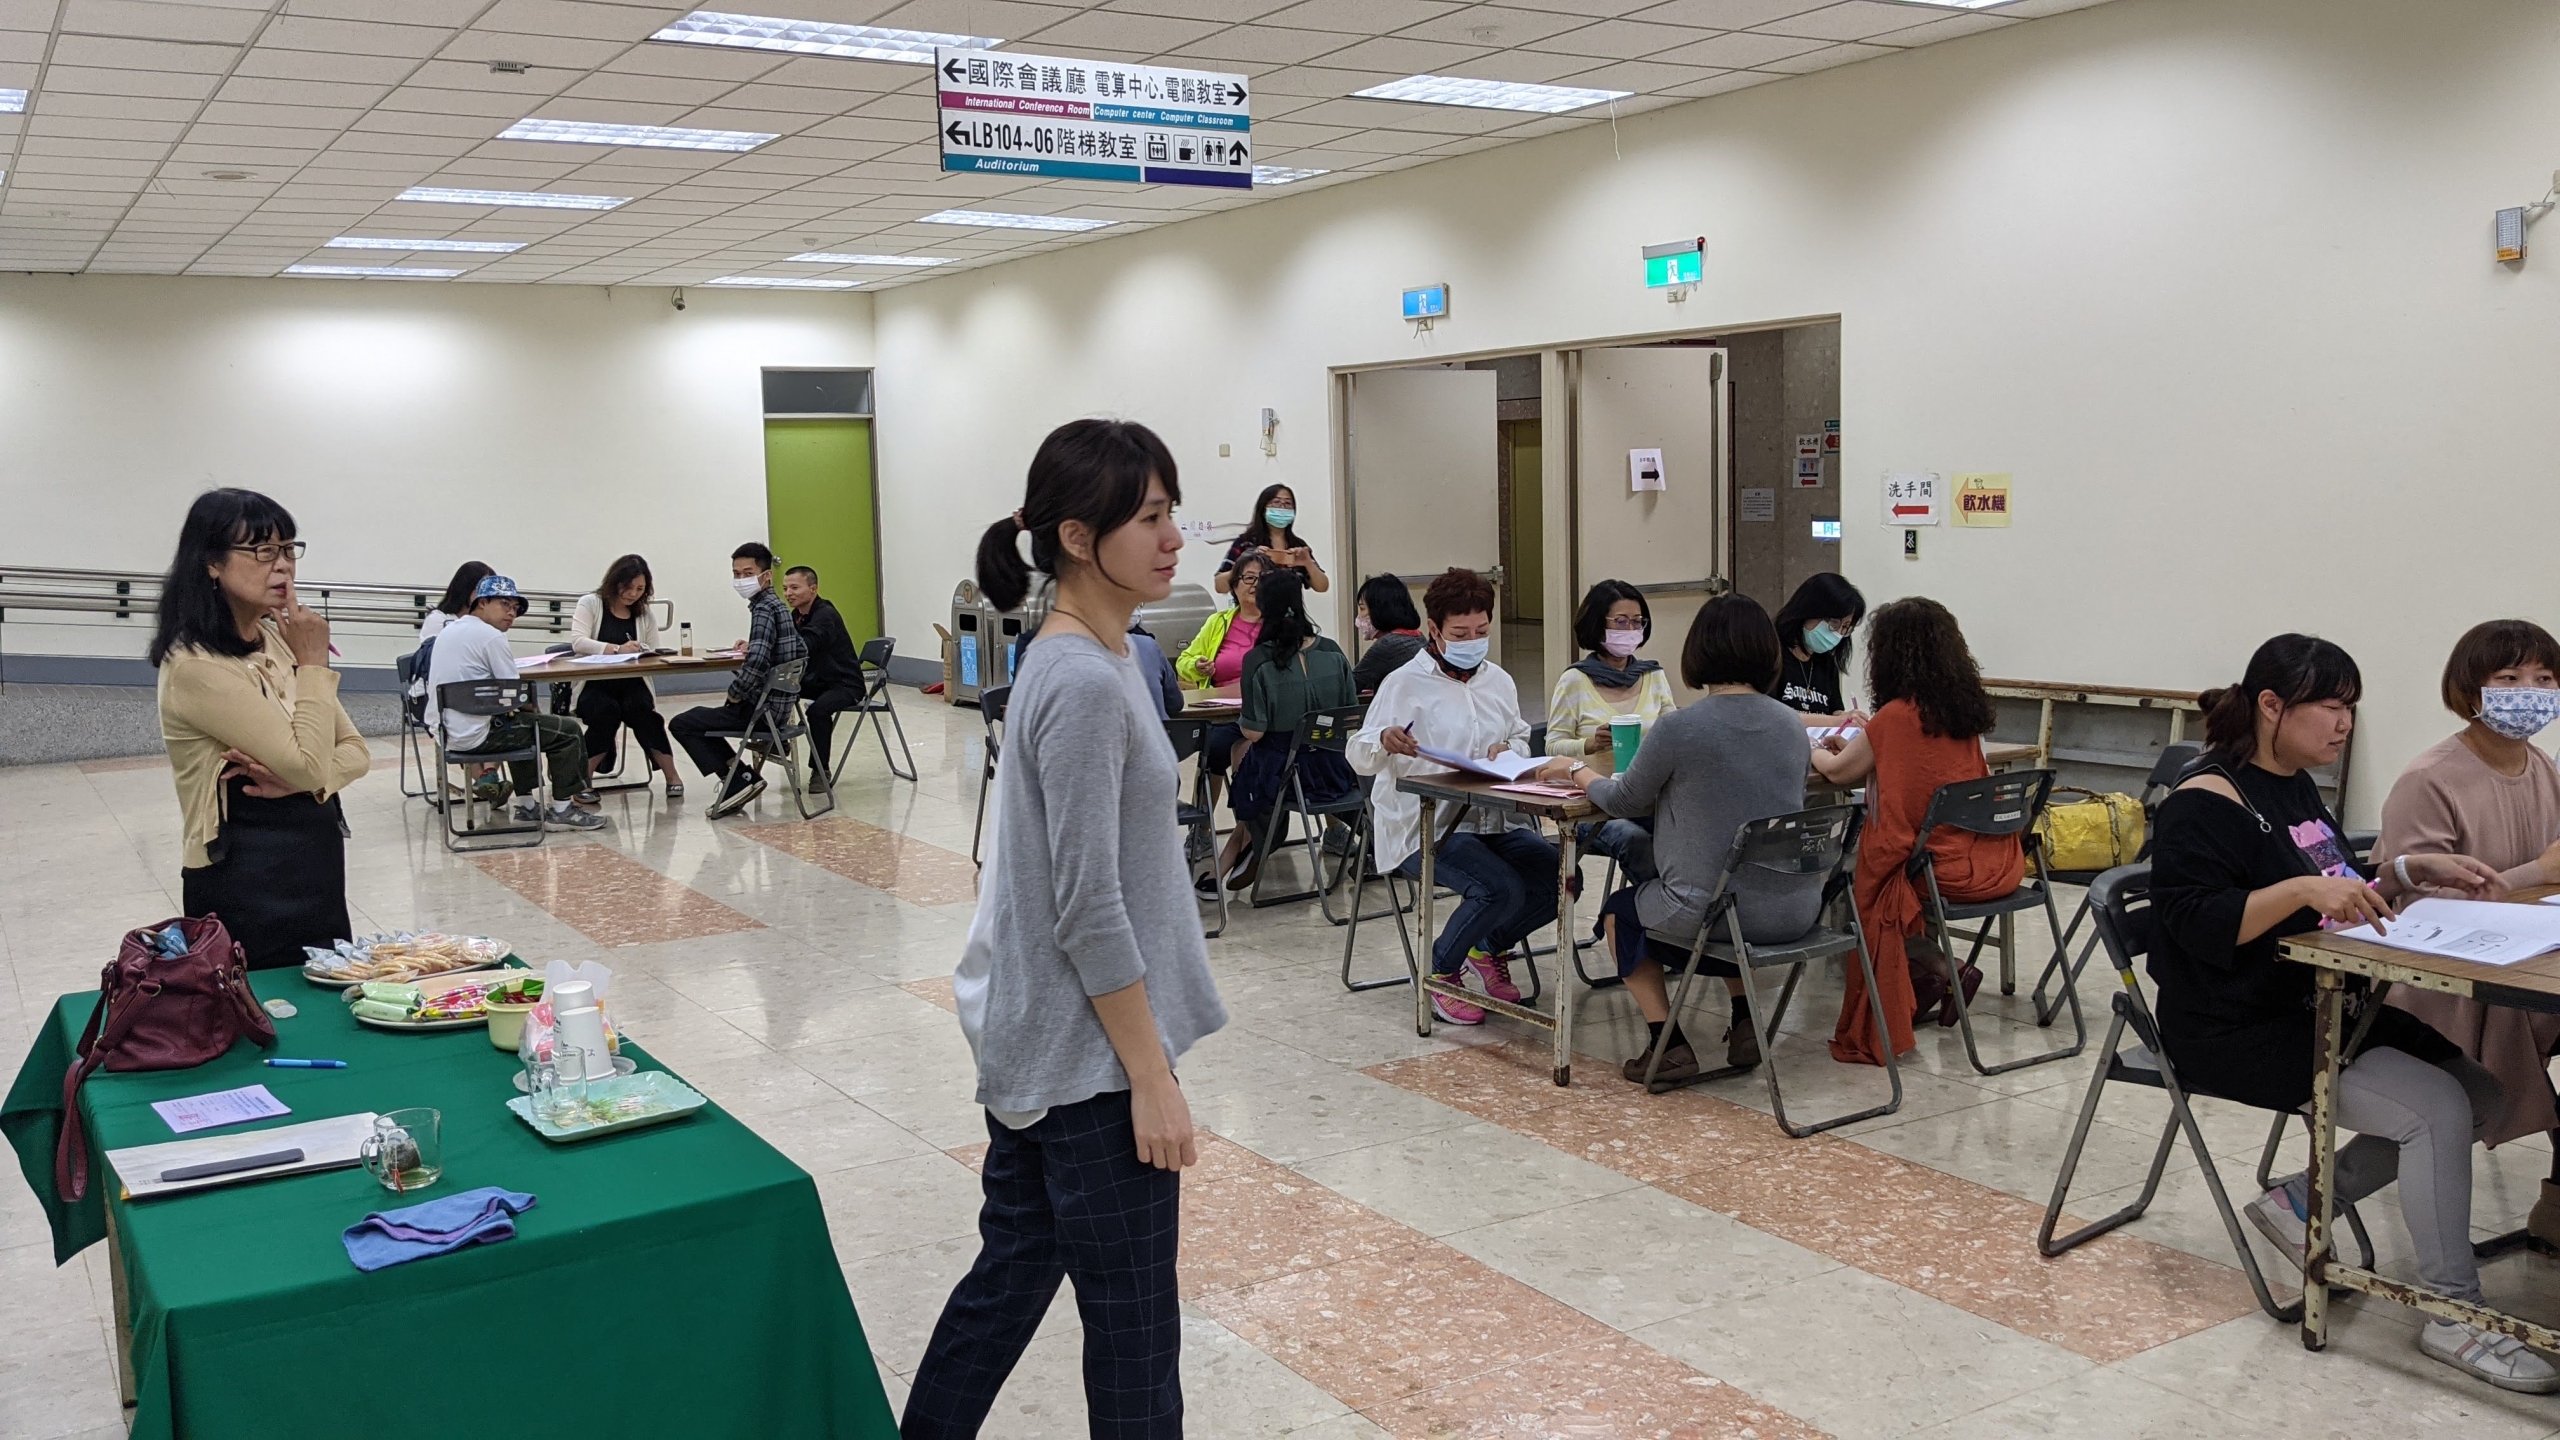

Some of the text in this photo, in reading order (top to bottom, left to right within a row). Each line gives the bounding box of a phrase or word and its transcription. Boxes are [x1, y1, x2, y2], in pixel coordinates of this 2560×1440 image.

[967, 57, 1087, 95] 國際會議廳
[965, 96, 1090, 115] International Conference Room
[1094, 105, 1234, 126] Computer center Computer Classroom
[975, 158, 1040, 172] Auditorium
[1888, 480, 1932, 498] 洗手間
[1963, 494, 2006, 511] 飲水機
